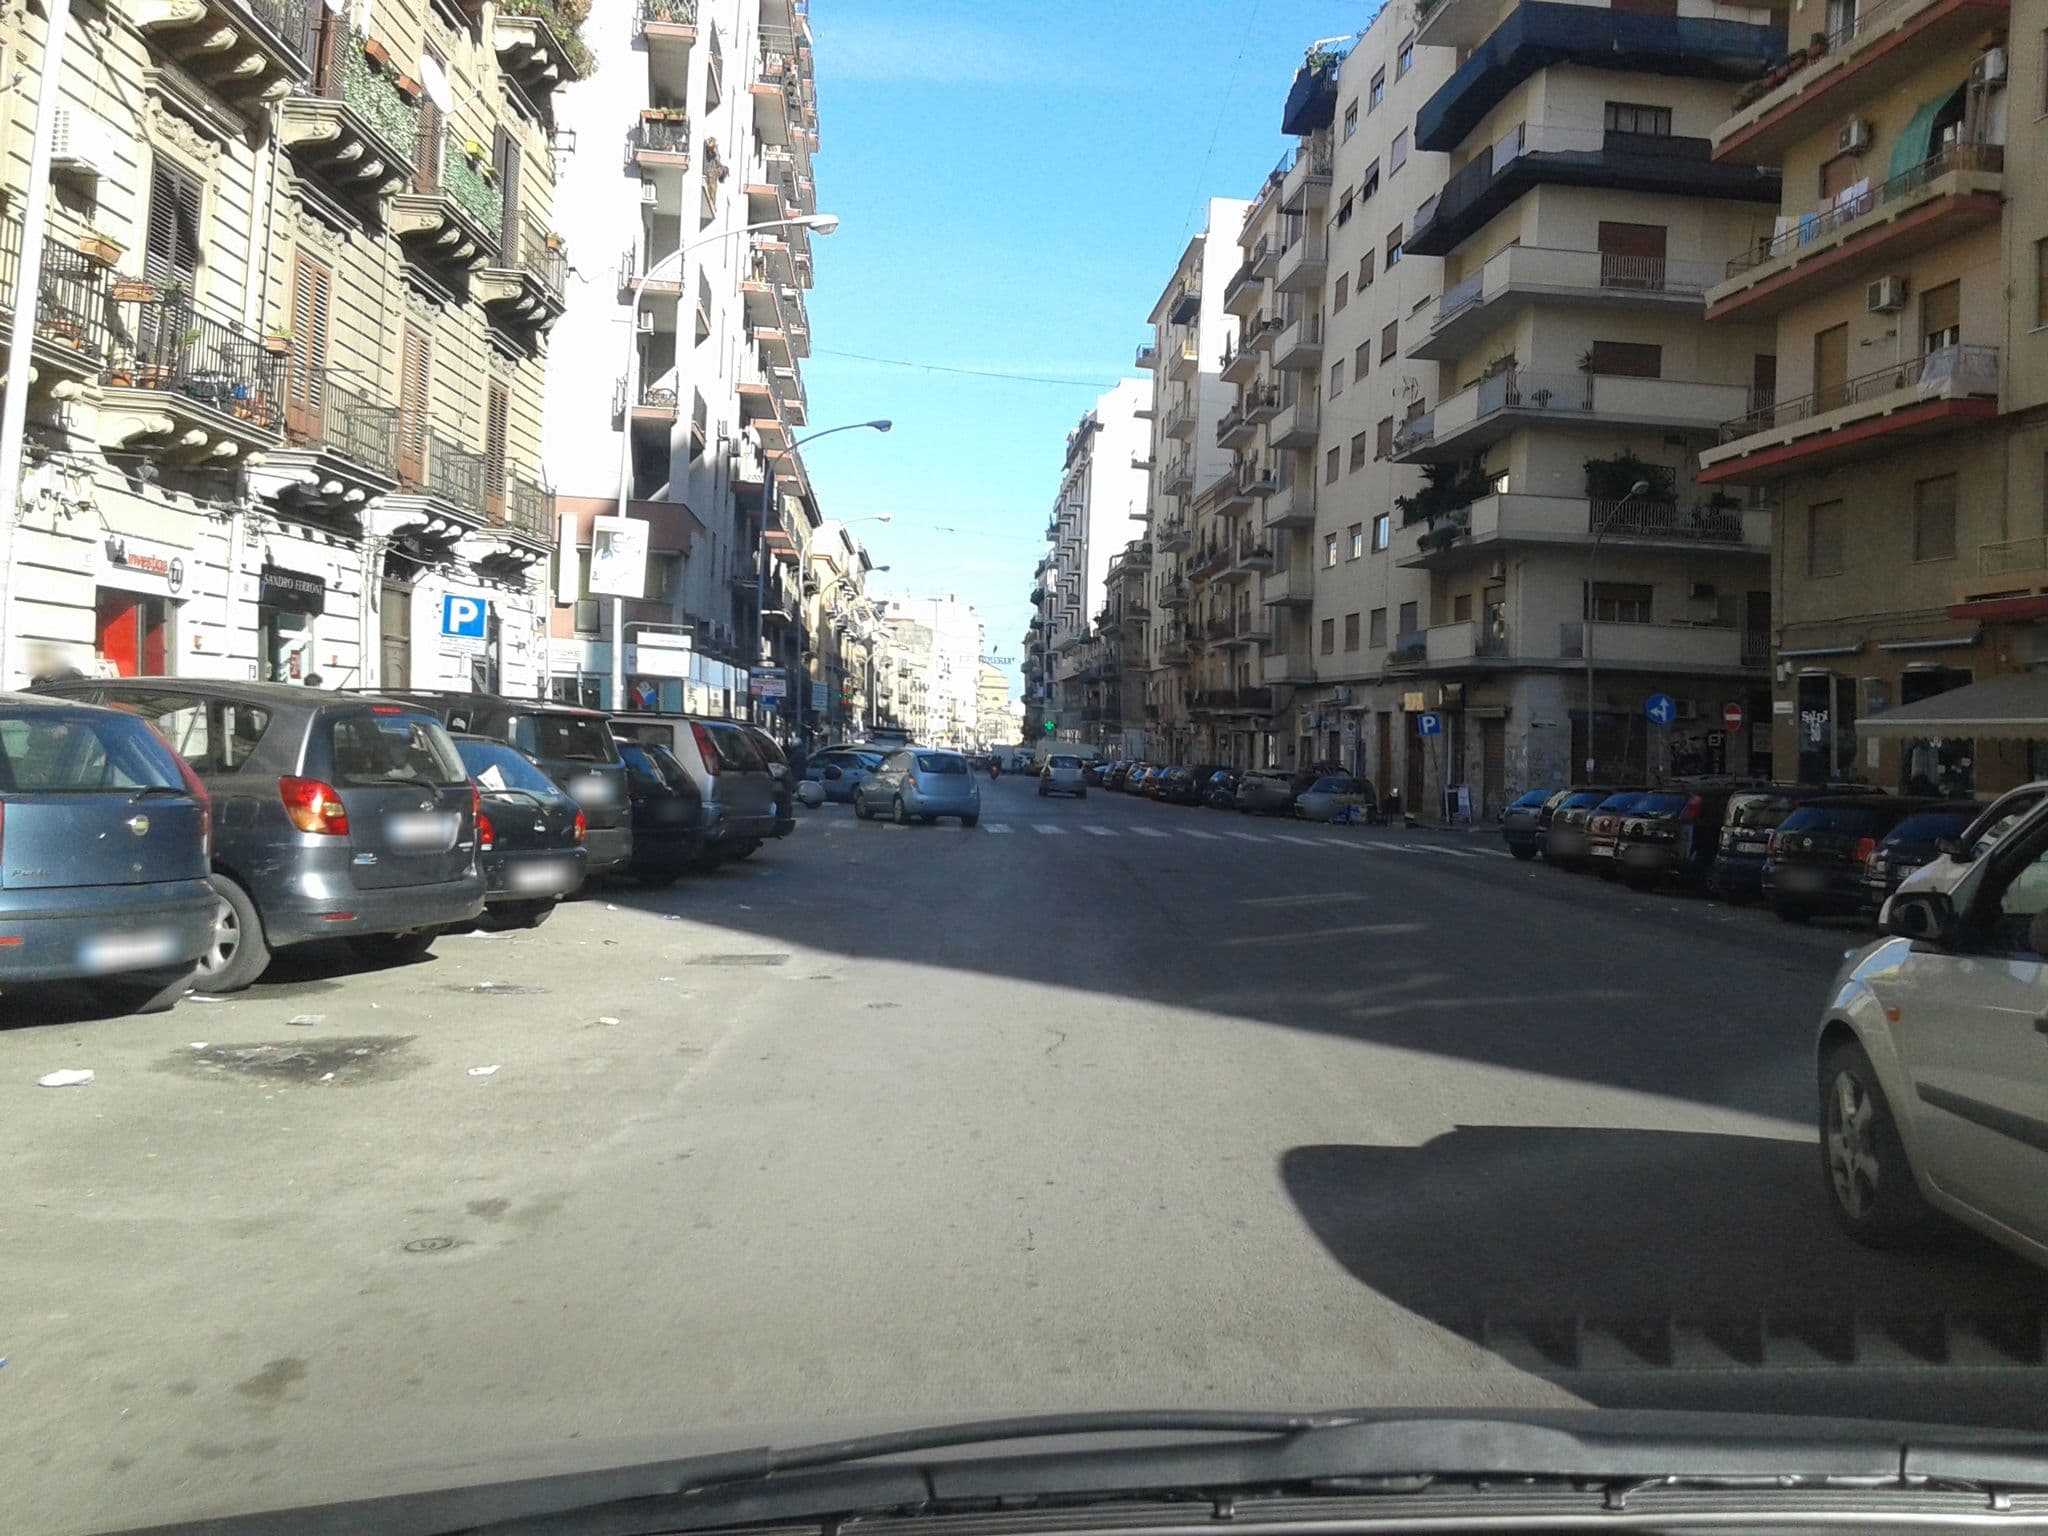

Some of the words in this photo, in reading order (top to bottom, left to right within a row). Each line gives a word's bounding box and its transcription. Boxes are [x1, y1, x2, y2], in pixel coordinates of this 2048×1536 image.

[263, 573, 294, 589] SANDRO
[451, 599, 478, 632] P
[1422, 716, 1437, 733] P
[1801, 710, 1829, 723] SALDI
